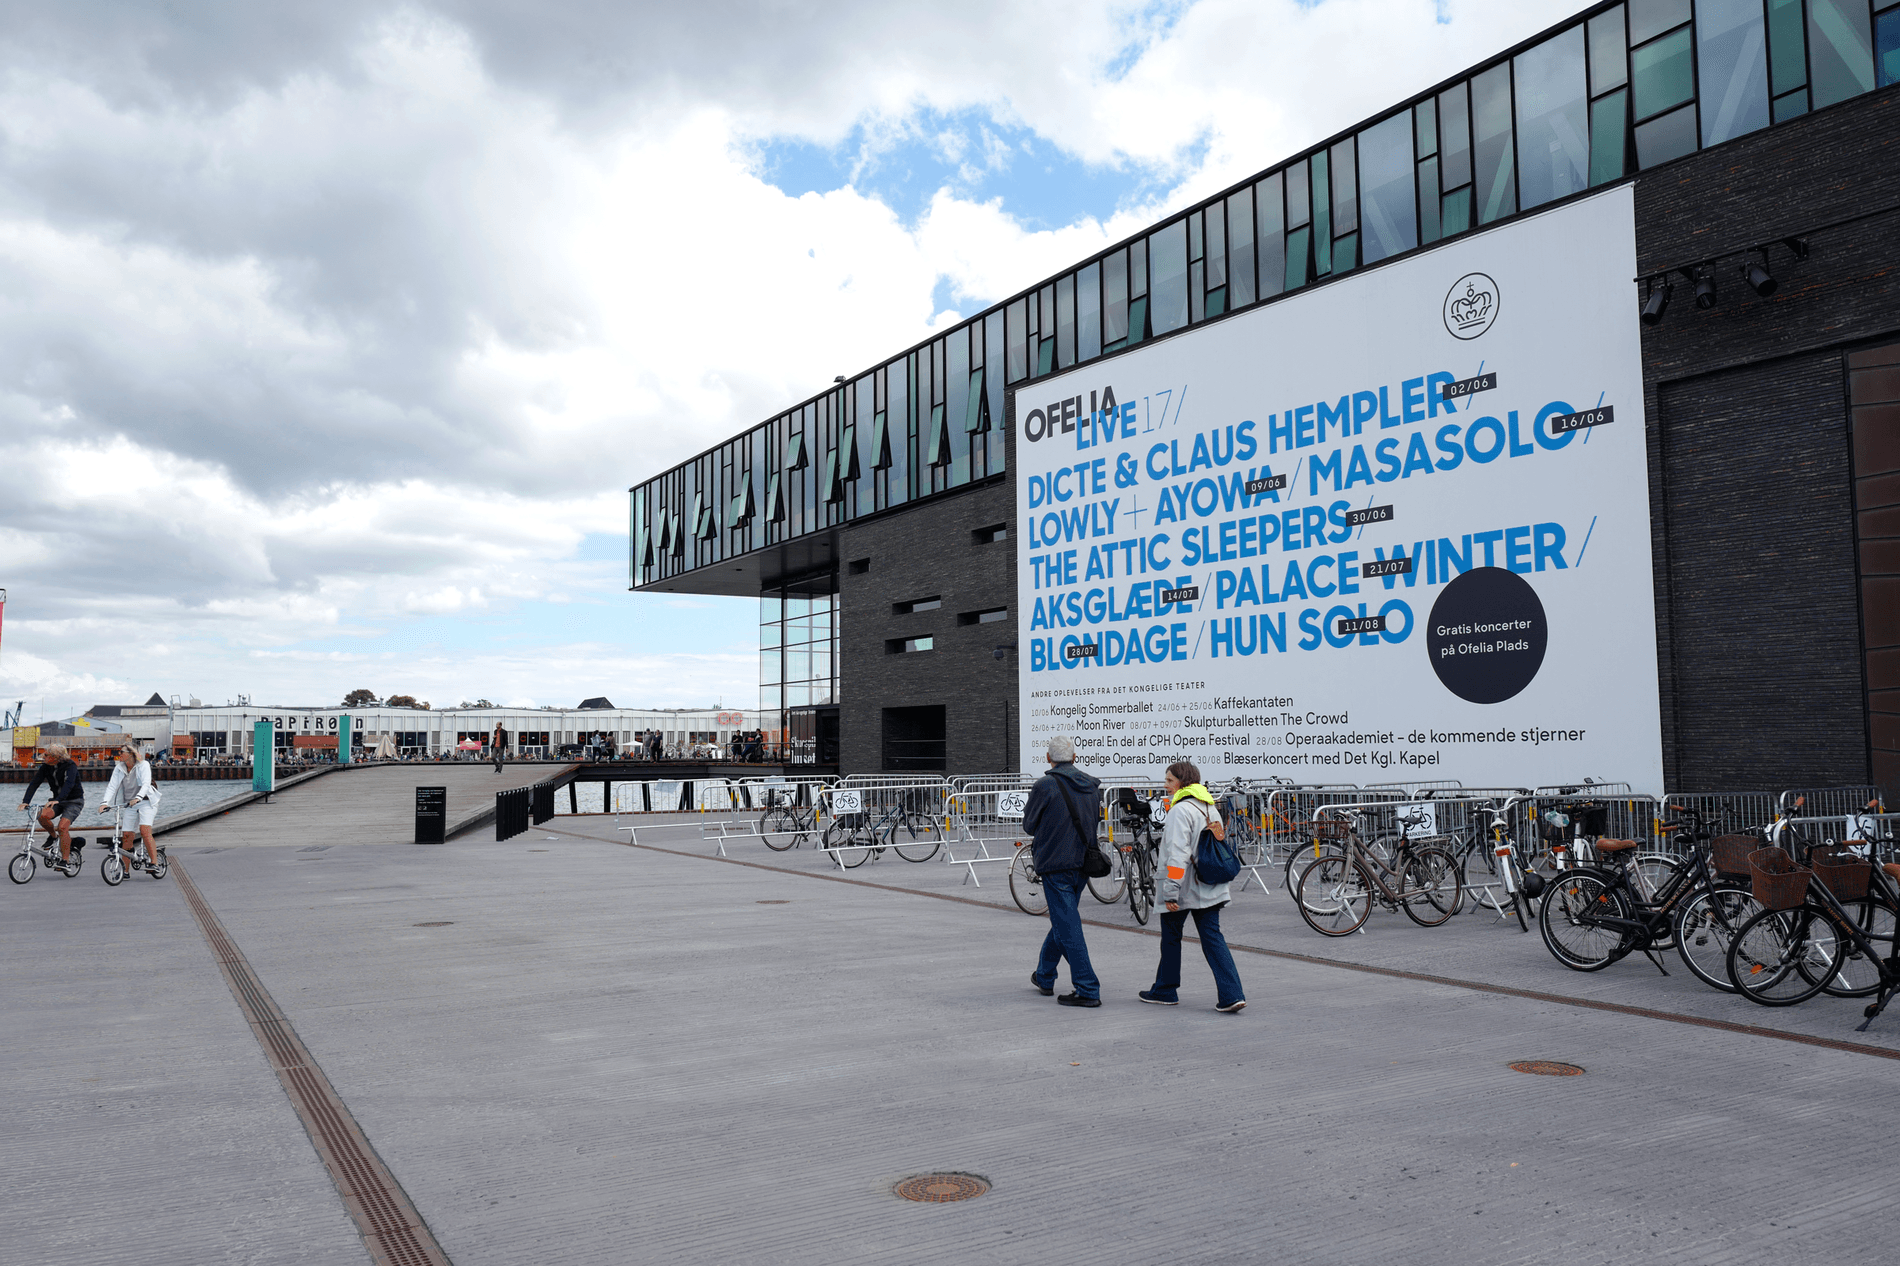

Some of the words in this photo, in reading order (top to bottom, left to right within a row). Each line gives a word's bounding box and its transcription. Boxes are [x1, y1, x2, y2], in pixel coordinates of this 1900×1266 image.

[1450, 378, 1489, 396] 02/06
[1024, 385, 1120, 443] OFELIA
[1560, 410, 1605, 430] 16/06
[1076, 400, 1137, 451] LIVE
[1028, 457, 1106, 510] DICTE
[1114, 451, 1139, 489] &
[1145, 420, 1258, 481] CLAUS
[1268, 371, 1457, 455] HEMPLER
[1028, 497, 1120, 550] LOWLY
[1123, 493, 1148, 530] +
[1153, 464, 1281, 526] AYOWA
[1308, 400, 1578, 496] MASASOLO
[1250, 477, 1281, 492] 09/06
[1352, 508, 1387, 524] 30/06
[1029, 549, 1078, 590] THE
[1084, 532, 1172, 582] ATTIC
[1181, 500, 1352, 568] SLEEPERS
[1030, 575, 1193, 631] AKSGLÆDE
[1215, 550, 1360, 610] PALACE
[1373, 521, 1569, 590] WINTER
[1369, 561, 1405, 576] 21/07
[1167, 590, 1194, 600] 14/07
[1030, 622, 1187, 672] BLONDAGE
[1210, 611, 1287, 659] HUN
[1297, 598, 1414, 651] SOLO
[1344, 619, 1380, 632] 11/08
[1436, 623, 1472, 637] Gratis
[1474, 618, 1532, 634] koncerter
[1071, 646, 1094, 657] 28/07
[1440, 644, 1456, 659] på
[1458, 640, 1494, 656] Ofelia
[1496, 638, 1529, 652] Plads
[1031, 690, 1052, 699] ANDRE
[1053, 687, 1096, 697] OPLEVELSER
[1097, 686, 1111, 695] FRA
[1113, 685, 1127, 694] DET
[1129, 682, 1173, 693] KONGELIGE
[1175, 681, 1206, 691] TEATER
[1050, 703, 1087, 718] Kongelig
[1088, 701, 1154, 715] Sommerballet
[1157, 703, 1181, 712] 24/06
[1189, 701, 1213, 710] 25/06
[1214, 696, 1294, 709] Kaffekantaten
[1031, 723, 1050, 732] 26/06
[1056, 723, 1075, 732] 27/06
[1076, 719, 1101, 731] Moon
[1102, 718, 1126, 730] River
[1129, 721, 1151, 730] 08/07
[1159, 720, 1182, 729] 09/07
[1184, 713, 1278, 730] Skulpturballetten
[1280, 712, 1303, 725] The
[1305, 711, 1349, 725] Crowd
[1106, 735, 1118, 747] En
[1120, 735, 1135, 747] del
[1137, 735, 1147, 746] af
[1149, 734, 1171, 746] CPH
[1173, 734, 1206, 749] Opera
[1208, 733, 1251, 746] Festival
[1256, 736, 1283, 745] 28/08
[1285, 731, 1394, 748] Operaakademiet
[1408, 729, 1426, 743] de
[1430, 728, 1516, 743] kommende
[1520, 727, 1586, 745] stjerner
[1031, 756, 1048, 764] 29/0
[1074, 752, 1111, 767] ongelige
[1112, 752, 1147, 767] Operas
[1196, 756, 1221, 764] 30/08
[1223, 752, 1309, 765] Blæserkoncert
[1312, 752, 1340, 765] med
[1344, 752, 1367, 765] Det
[1371, 751, 1397, 768] Kgl.
[1399, 751, 1440, 768] Kapel
